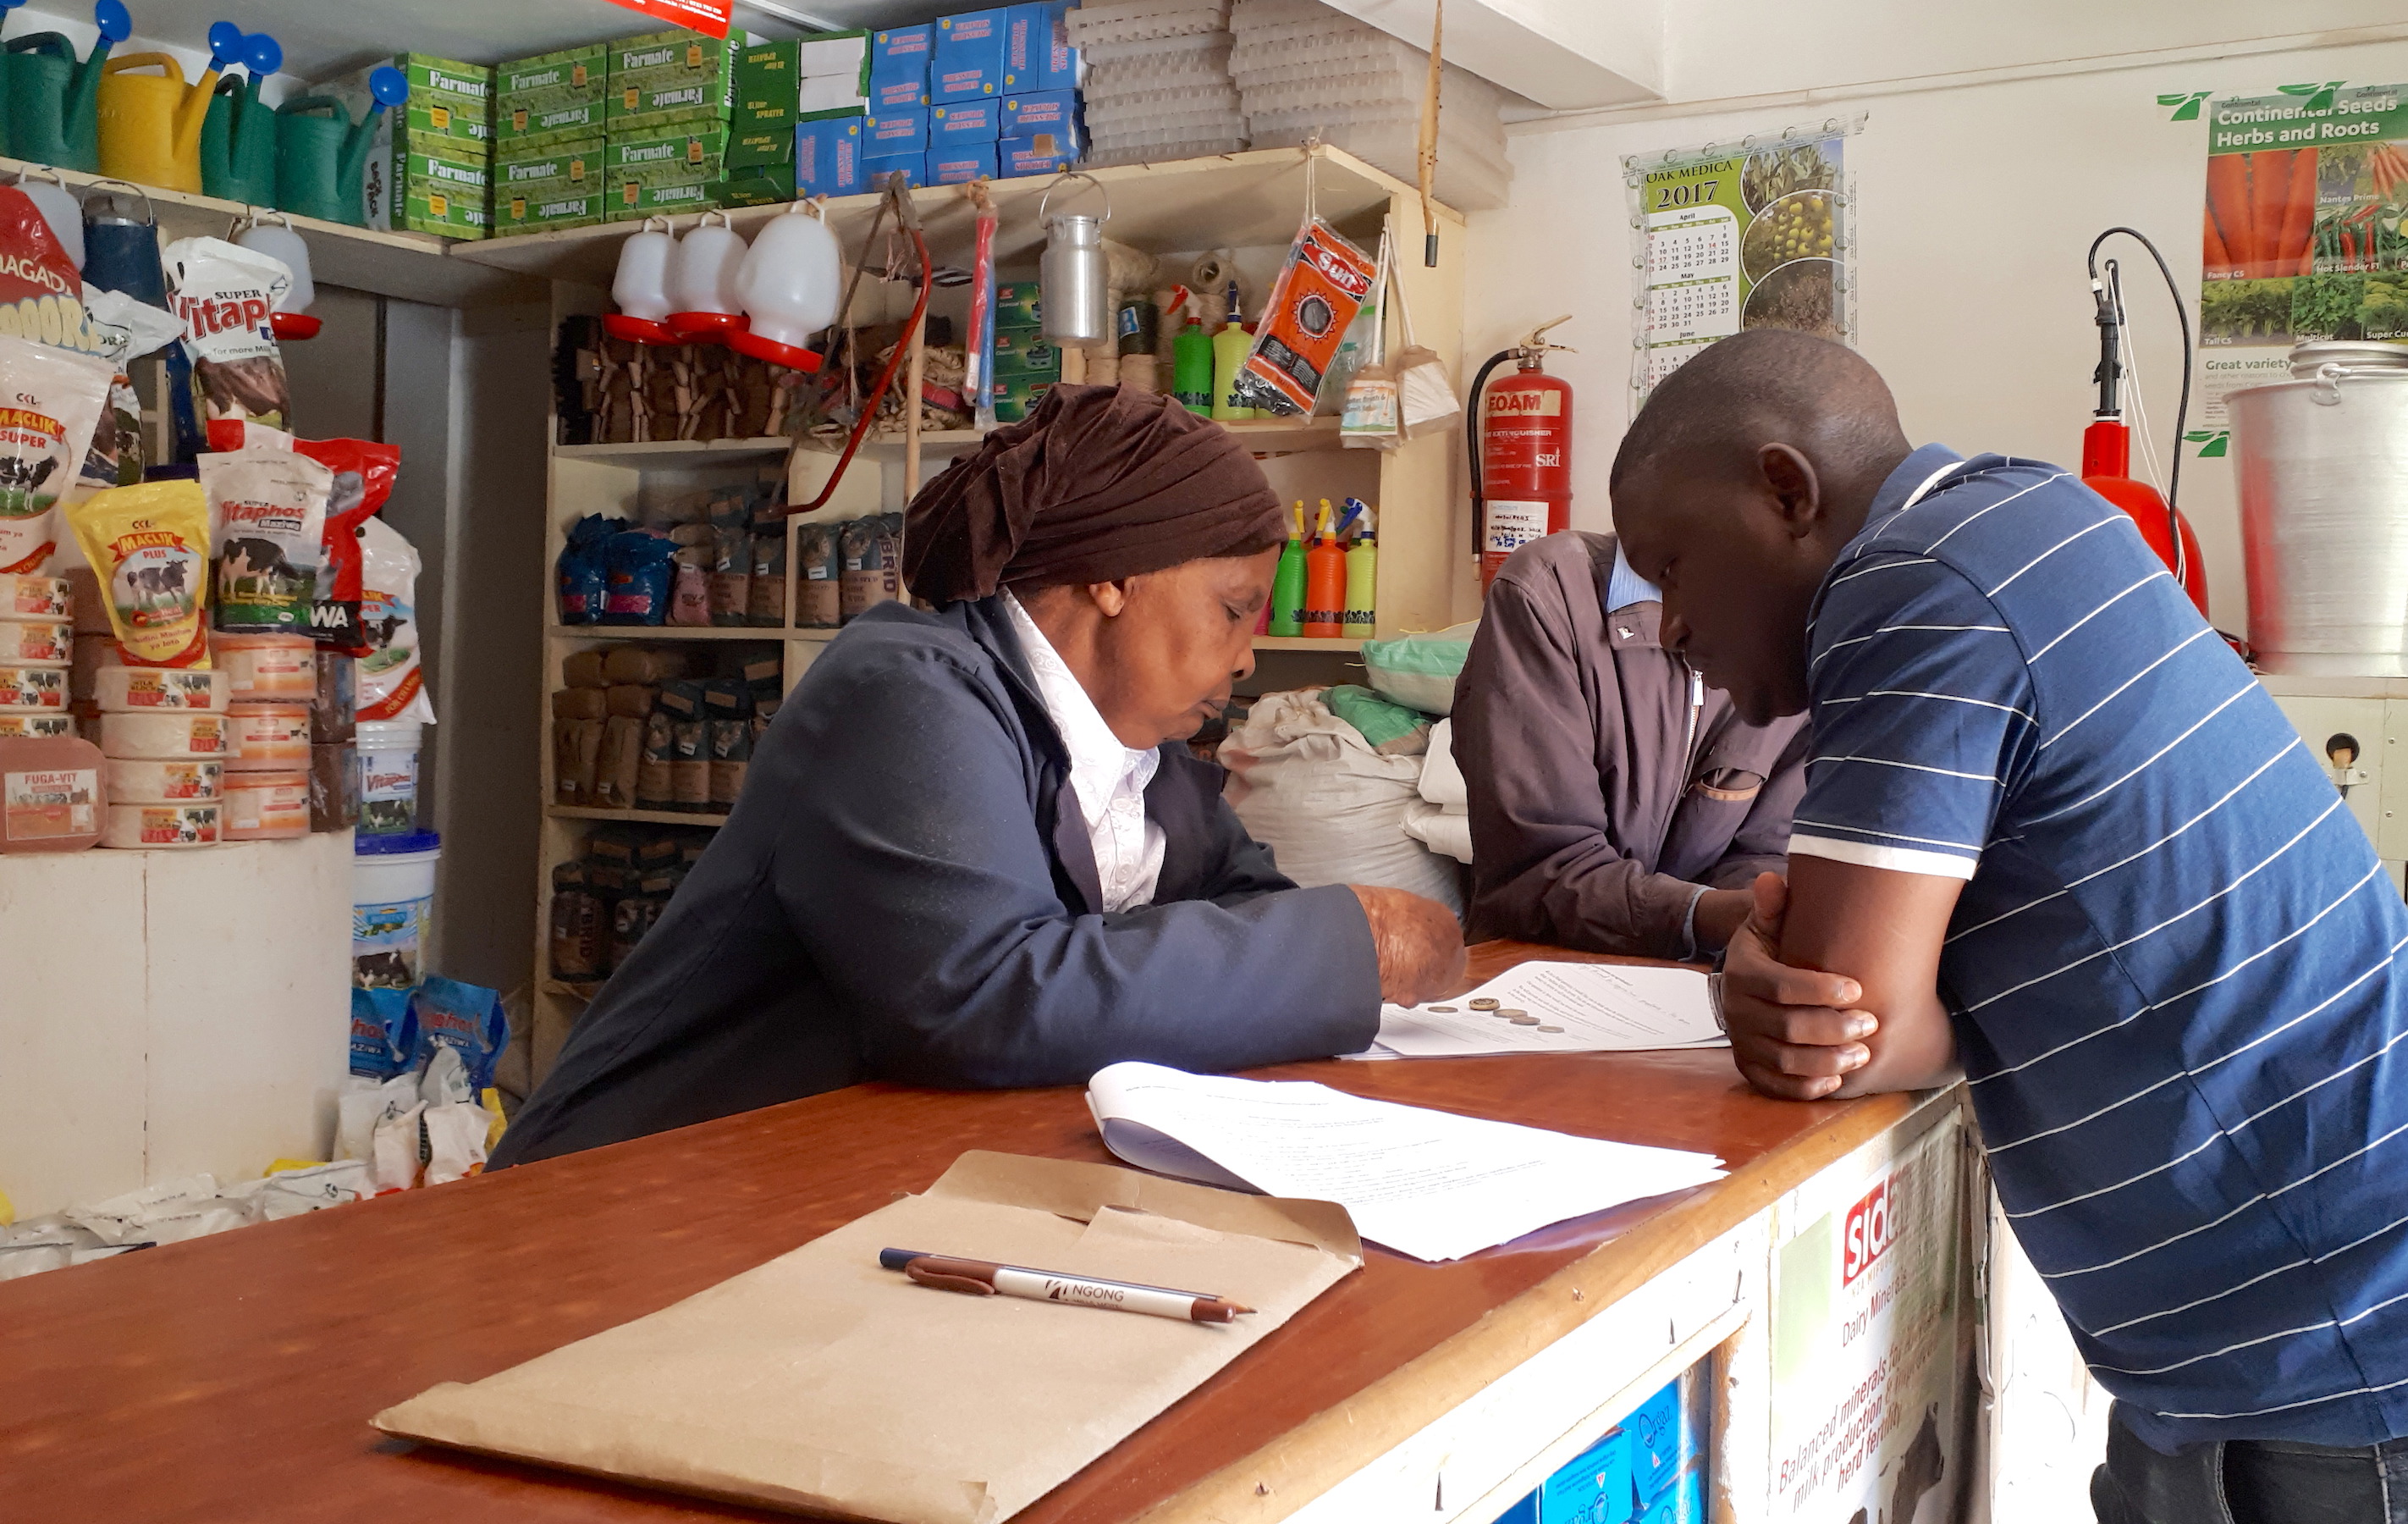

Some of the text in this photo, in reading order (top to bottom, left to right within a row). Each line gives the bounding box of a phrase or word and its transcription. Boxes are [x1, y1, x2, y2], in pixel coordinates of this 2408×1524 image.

[623, 47, 675, 69] Farmate
[511, 69, 560, 91] Farmate
[2338, 96, 2398, 115] Seeds
[2217, 120, 2380, 147] Herbs and Roots
[622, 142, 675, 163] Farmate
[508, 162, 558, 182] Farmate
[1679, 160, 1733, 179] MEDICA
[1656, 180, 1719, 209] 2017
[2320, 193, 2380, 204] Nantes Prime
[0, 254, 74, 296] AGAD
[1317, 251, 1357, 290] Sun
[2207, 271, 2232, 280] Fancy
[2317, 264, 2334, 272] Hot
[2336, 262, 2369, 271] Slender
[215, 289, 262, 300] SUPER
[166, 293, 271, 344] Vitap
[2366, 331, 2392, 340] Super
[229, 346, 253, 355] more
[2205, 358, 2292, 370] Great variety
[0, 409, 57, 434] MACLIK
[0, 430, 47, 449] SUPER
[118, 533, 174, 554] MACLIK
[142, 550, 166, 559] PLUS
[309, 605, 349, 628] WA
[25, 772, 78, 785] FUGA-VIT
[1073, 1284, 1124, 1302] NGONG
[1843, 1270, 1907, 1348] Dairy Minerals
[1639, 1405, 1673, 1449] Orgaz
[1779, 1404, 1838, 1495] Balanced
[1840, 1355, 1887, 1427] minerals
[1793, 1461, 1819, 1513] milk
[1822, 1394, 1883, 1486] production
[1838, 1401, 1903, 1494] herd fertility
